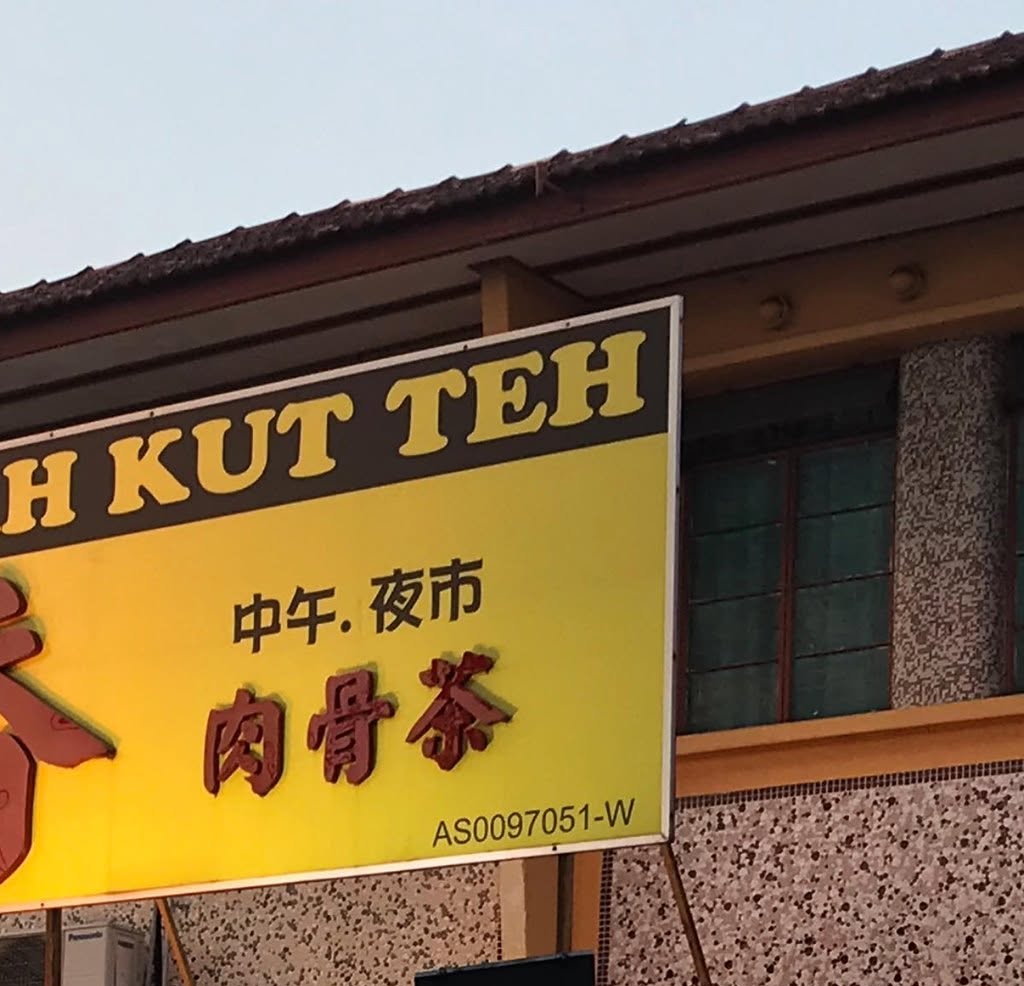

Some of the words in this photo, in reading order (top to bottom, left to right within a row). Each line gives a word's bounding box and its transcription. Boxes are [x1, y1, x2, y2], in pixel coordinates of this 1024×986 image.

[108, 394, 353, 514] KUT
[386, 332, 645, 455] TEH
[204, 650, 513, 797] 肉骨茶
[432, 798, 636, 847] AS0097051-W
